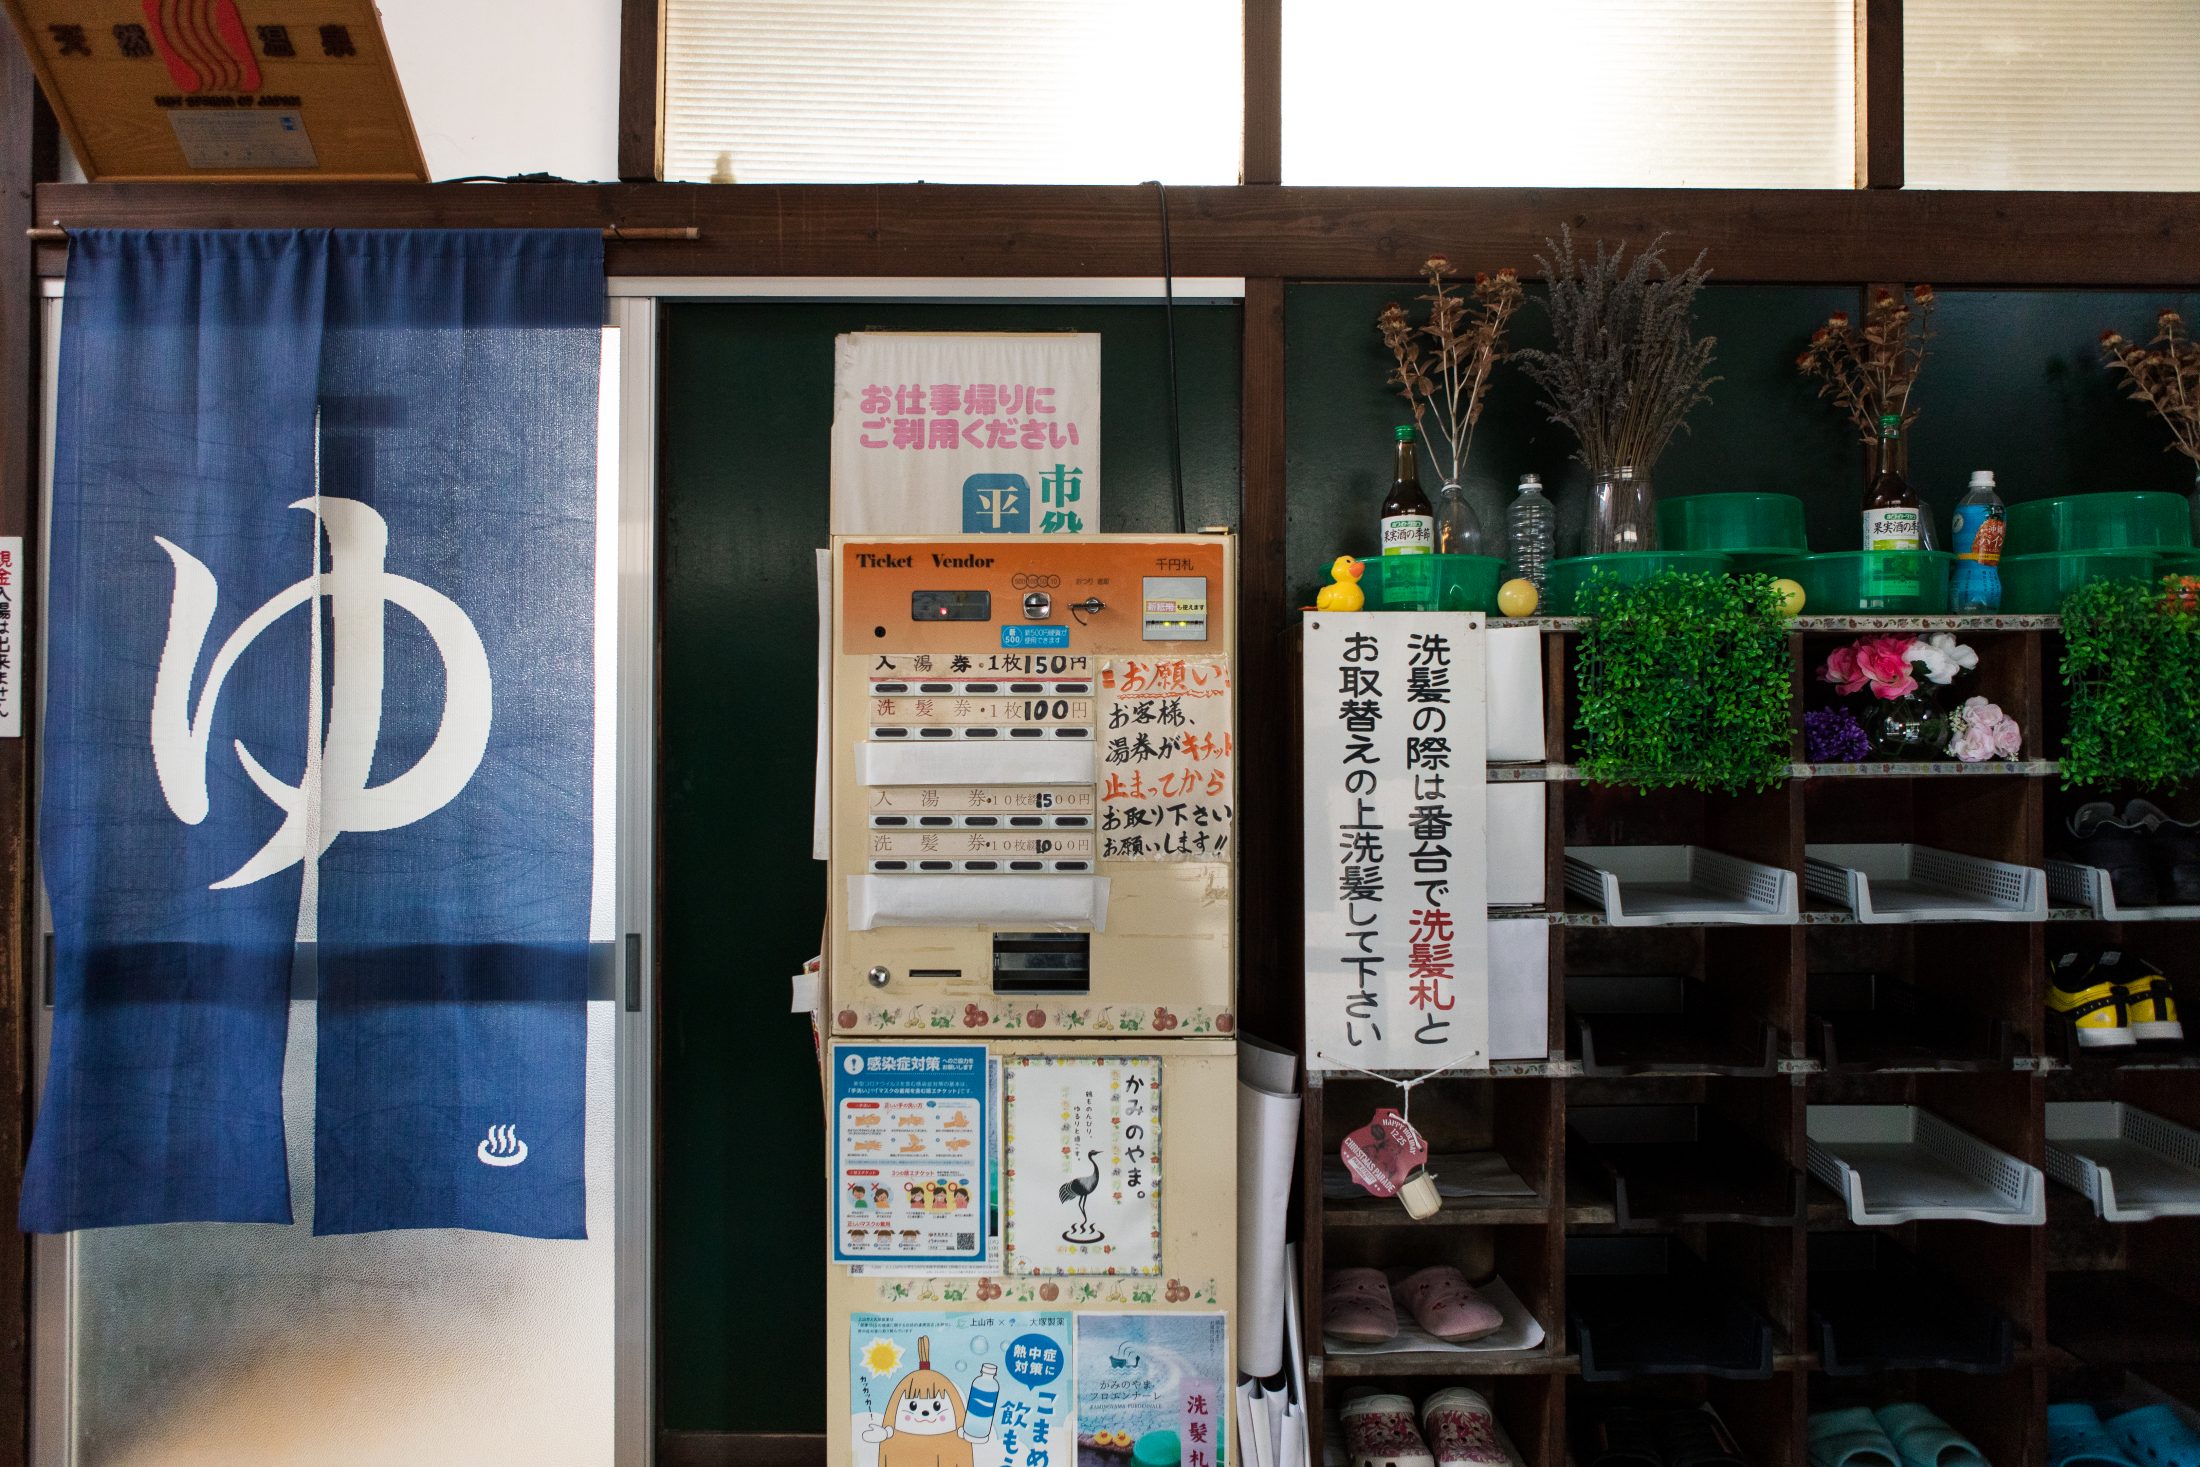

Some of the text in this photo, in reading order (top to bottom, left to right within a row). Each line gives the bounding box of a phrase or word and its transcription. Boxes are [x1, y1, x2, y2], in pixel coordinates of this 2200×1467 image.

[860, 384, 1056, 415] お仕事帰りに
[859, 418, 1080, 450] ご利用ください
[1384, 528, 1430, 542] 果実酒の季節
[857, 553, 995, 568] Ticket Vendor
[1156, 558, 1194, 571] 千円札
[151, 496, 492, 889] ゆ
[1102, 768, 1225, 802] 止まってから
[1102, 804, 1232, 831] お取り下さい
[1339, 631, 1386, 1046] お取替えの上洗髪して下さい
[1407, 633, 1456, 1045] 洗髪の際は番台で洗髪札と
[867, 1056, 940, 1071] 感染症対策
[1124, 1075, 1146, 1199] かみのやま。
[1382, 1118, 1405, 1130] HAPPY
[1344, 1137, 1377, 1171] CHRISTMAS
[1372, 1165, 1396, 1193] PARADE
[970, 1318, 994, 1326] 上山市
[1029, 1317, 1065, 1326] 大塚製薬
[1013, 1344, 1057, 1363] 熱中症
[1014, 1361, 1056, 1376] 対策に
[1027, 1391, 1059, 1467] こまめ
[1187, 1394, 1209, 1467] 洗髪札
